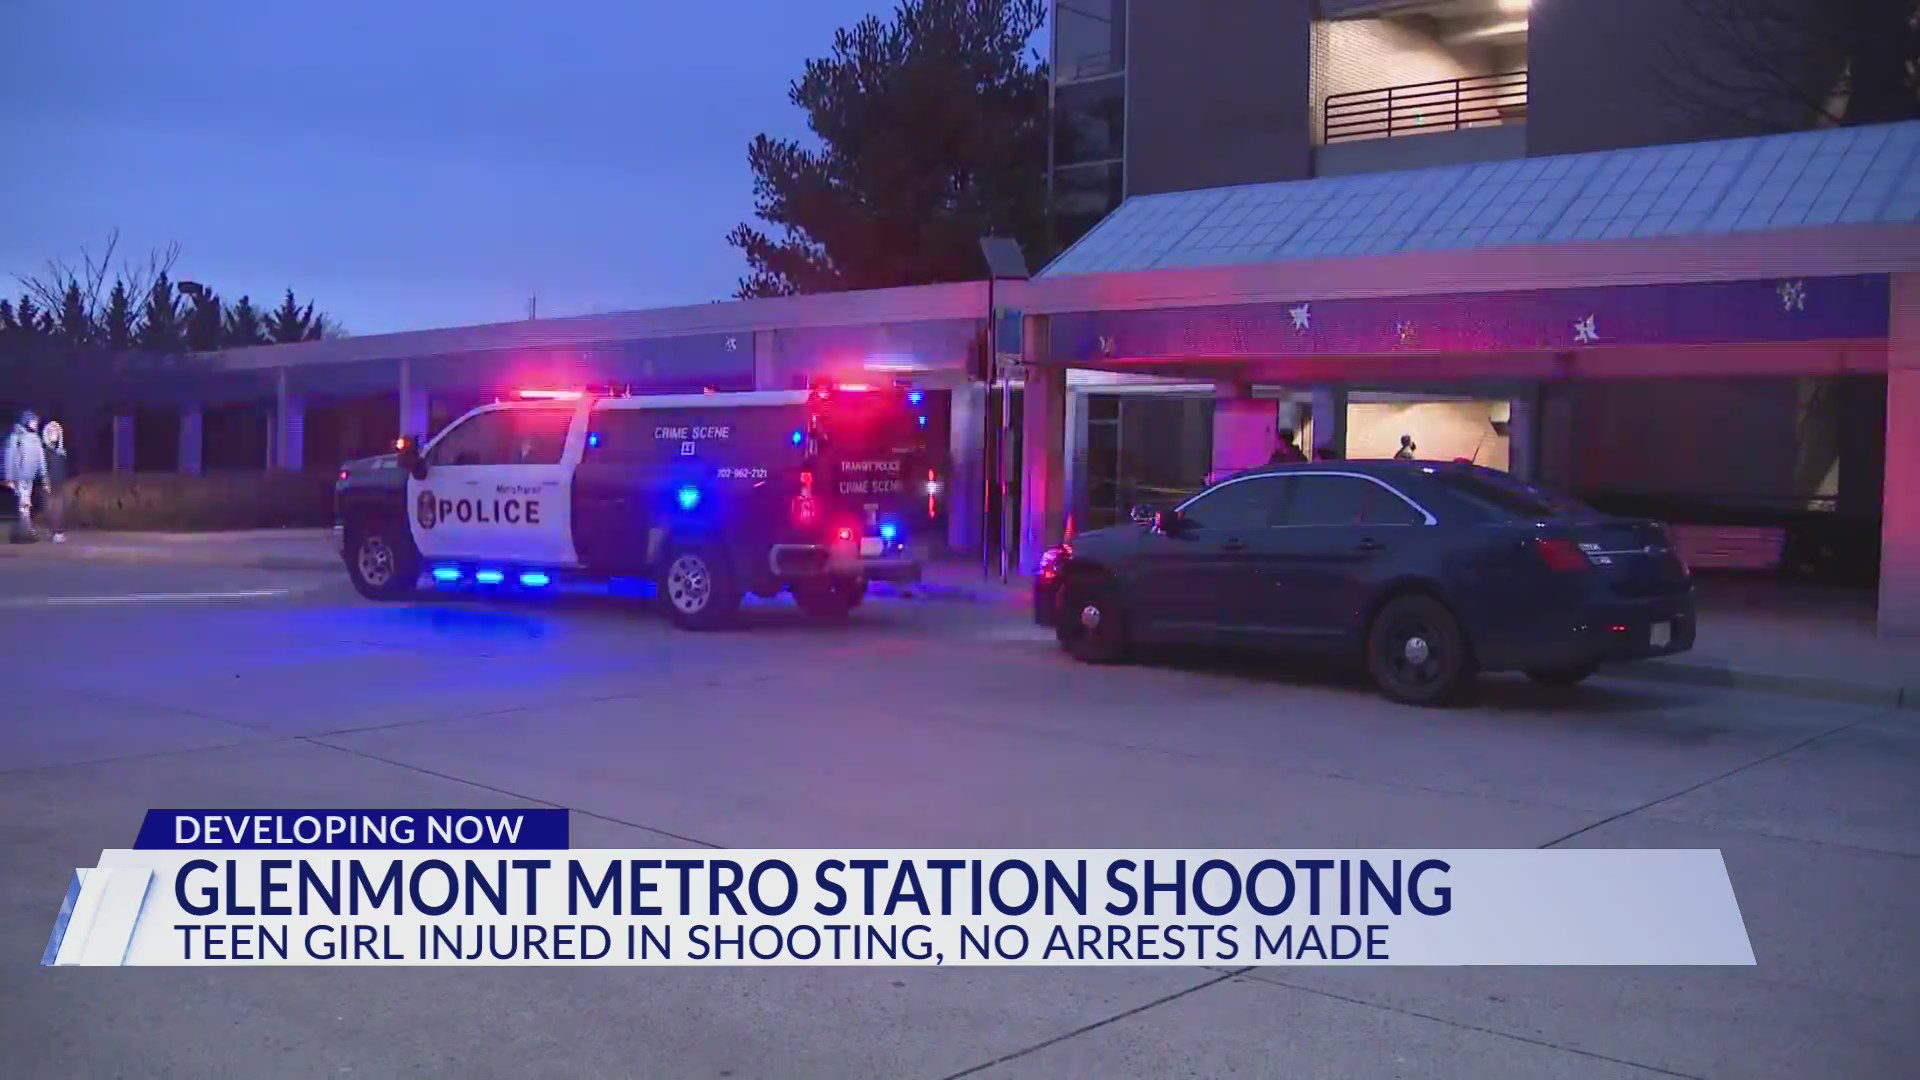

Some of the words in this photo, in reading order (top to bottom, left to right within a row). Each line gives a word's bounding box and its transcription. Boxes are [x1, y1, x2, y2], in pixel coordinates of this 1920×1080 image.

[654, 426, 689, 439] CRIME
[692, 426, 730, 439] SCENE
[839, 480, 869, 494] CRIME
[872, 479, 902, 493] SCEN
[439, 498, 541, 524] POLICE
